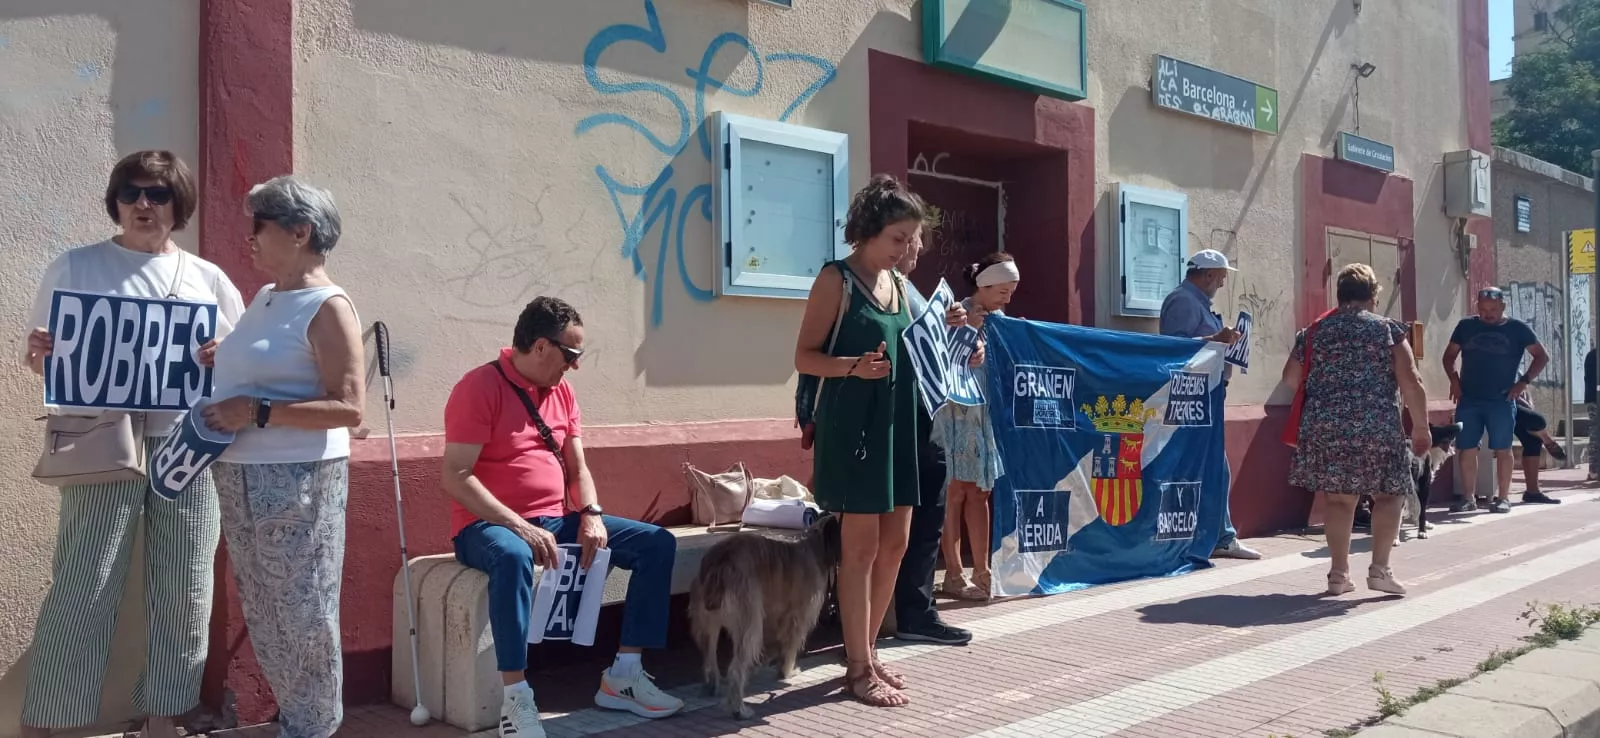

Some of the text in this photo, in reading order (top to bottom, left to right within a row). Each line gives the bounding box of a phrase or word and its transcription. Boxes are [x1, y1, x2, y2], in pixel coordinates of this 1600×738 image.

[1182, 77, 1236, 109] Barcelona
[50, 295, 210, 408] ROBRES
[1015, 368, 1072, 399] GRAÑEN
[1036, 495, 1044, 517] A
[1177, 487, 1184, 508] Y
